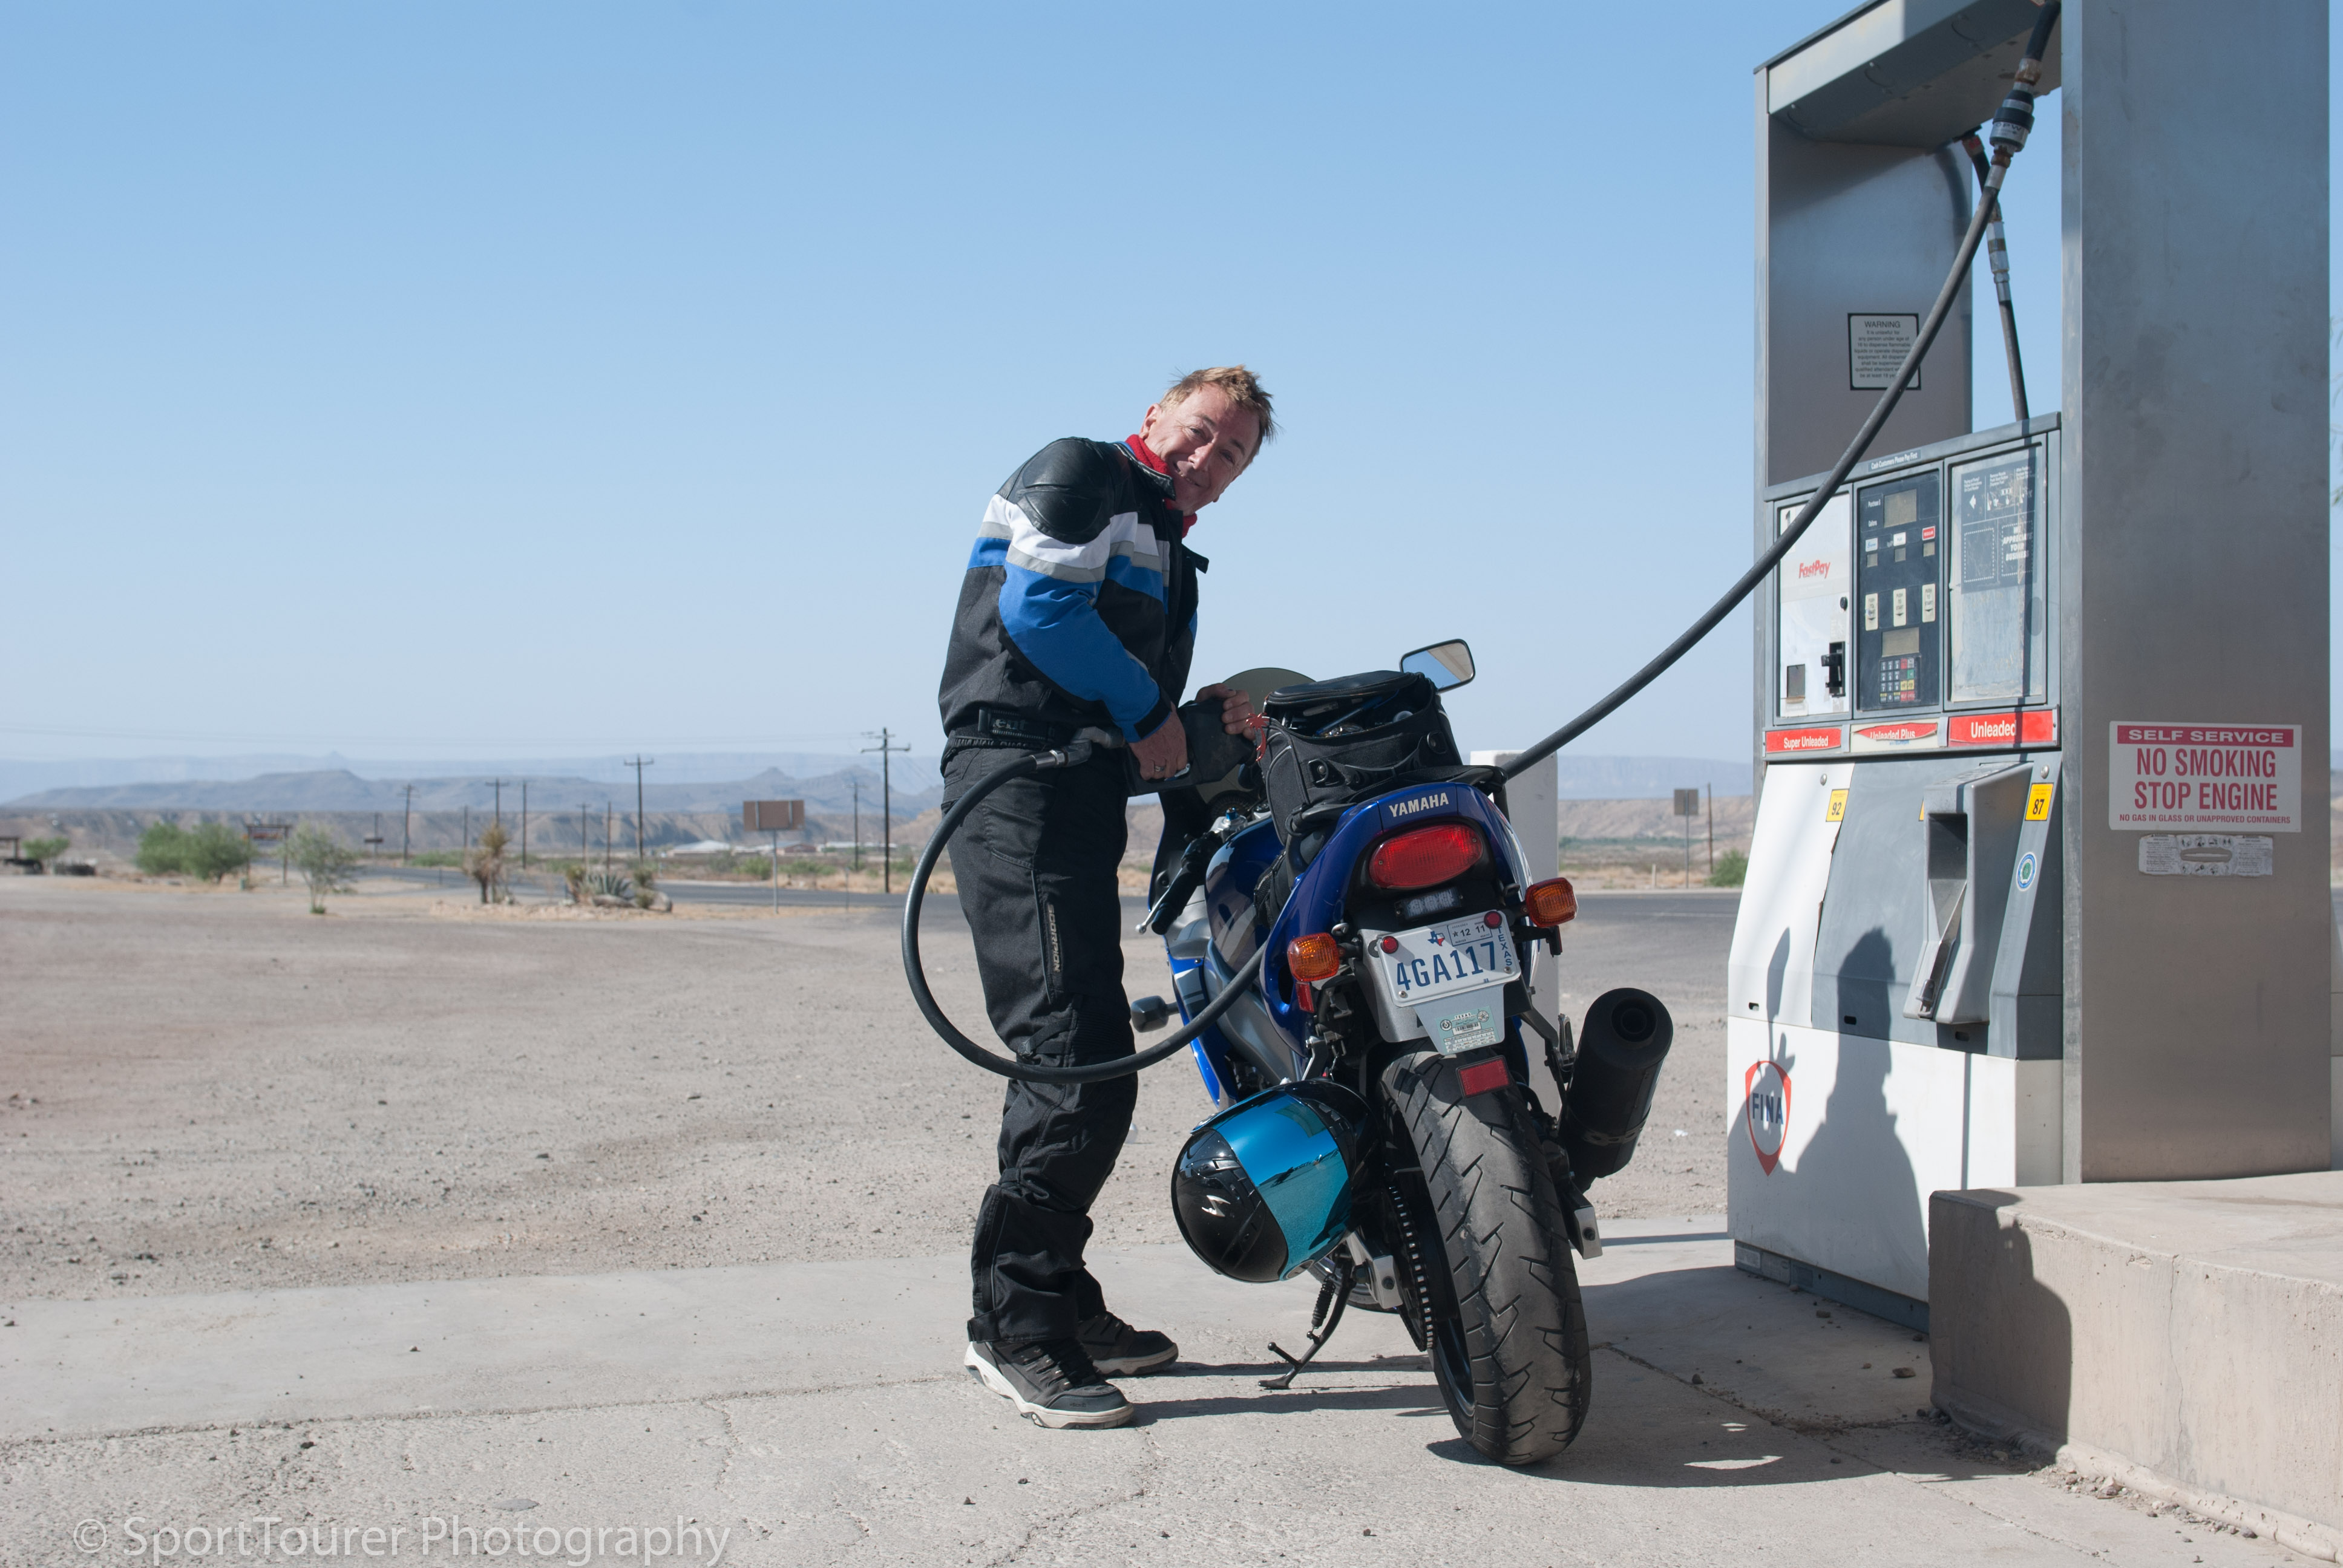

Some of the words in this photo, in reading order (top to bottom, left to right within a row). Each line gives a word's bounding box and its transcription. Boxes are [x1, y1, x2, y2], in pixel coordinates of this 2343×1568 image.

[1996, 122, 2022, 131] OPW
[1798, 560, 1830, 579] FastPay
[1870, 729, 1899, 740] Unleaded
[1901, 728, 1916, 739] Plus
[1971, 719, 2017, 738] Unleaded
[2129, 729, 2183, 741] SELF
[2190, 731, 2284, 743] SERVICE
[1784, 737, 1801, 751] Super
[1801, 735, 1829, 748] Unleaded
[2137, 748, 2167, 776] NO
[2175, 748, 2276, 778] SMOKING
[1388, 792, 1449, 818] YAMAHA
[2134, 781, 2191, 809] STOP
[2199, 782, 2277, 811] ENGINE
[1831, 802, 1842, 815] 92
[2033, 799, 2045, 815] 87
[2132, 814, 2147, 822] GAS
[2158, 814, 2182, 823] GLASS
[2197, 815, 2244, 823] UNAPPROVED
[2247, 815, 2290, 824] CONTAINERS
[1048, 904, 1060, 973] SCORPION
[1460, 928, 1471, 937] 12
[1475, 924, 1486, 933] 11
[1497, 926, 1512, 966] TEXAS
[1397, 941, 1495, 991] 4GA117
[1752, 1092, 1784, 1125] FINA
